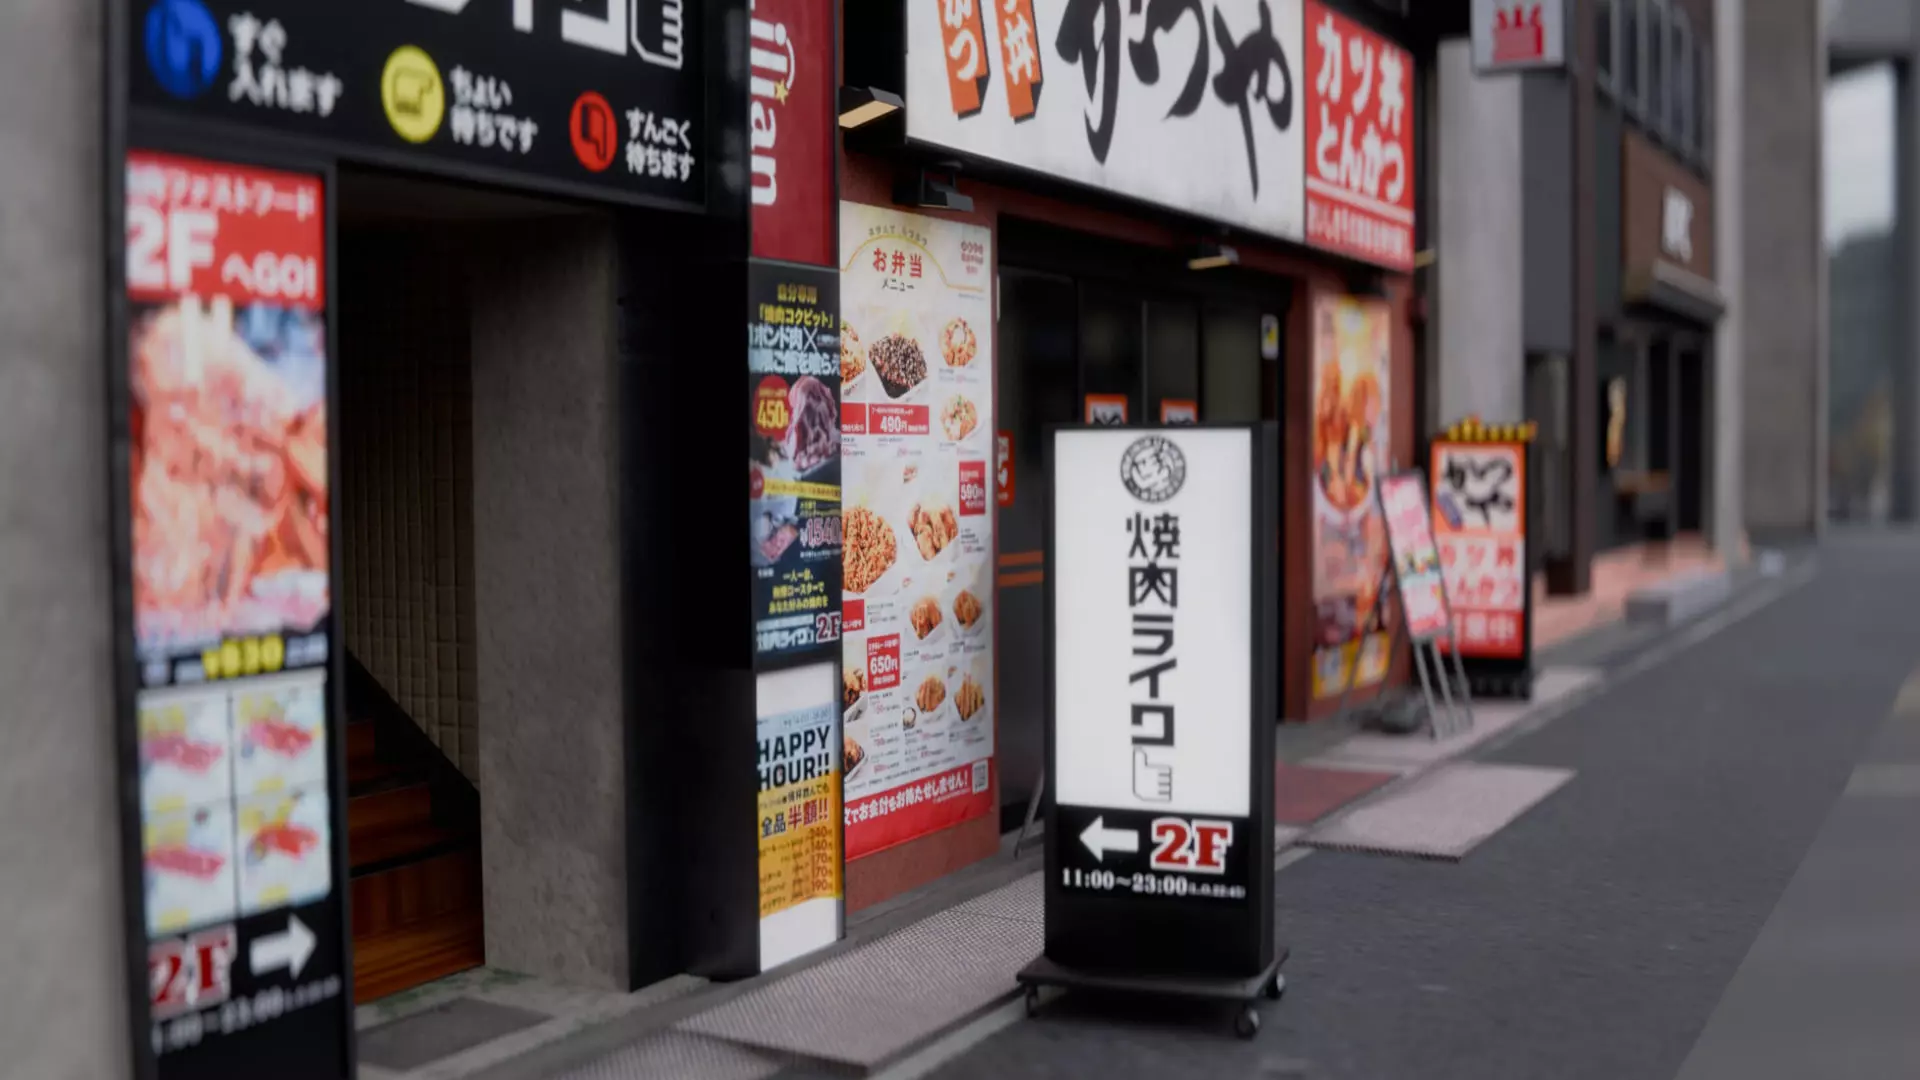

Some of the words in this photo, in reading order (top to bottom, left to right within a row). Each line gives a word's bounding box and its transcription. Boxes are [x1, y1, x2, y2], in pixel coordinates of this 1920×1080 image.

[750, 0, 795, 206] illian
[1316, 12, 1404, 137] カツ丼
[626, 139, 695, 182] 持ちます
[1316, 103, 1405, 203] とんかつ
[126, 203, 219, 292] 2F
[873, 247, 923, 279] お弁当
[881, 278, 915, 292] メニュー
[1126, 511, 1180, 747] 焼肉ライク
[757, 724, 830, 766] HAPPY
[757, 752, 829, 792] HOUR!!
[1150, 816, 1234, 875] 2F
